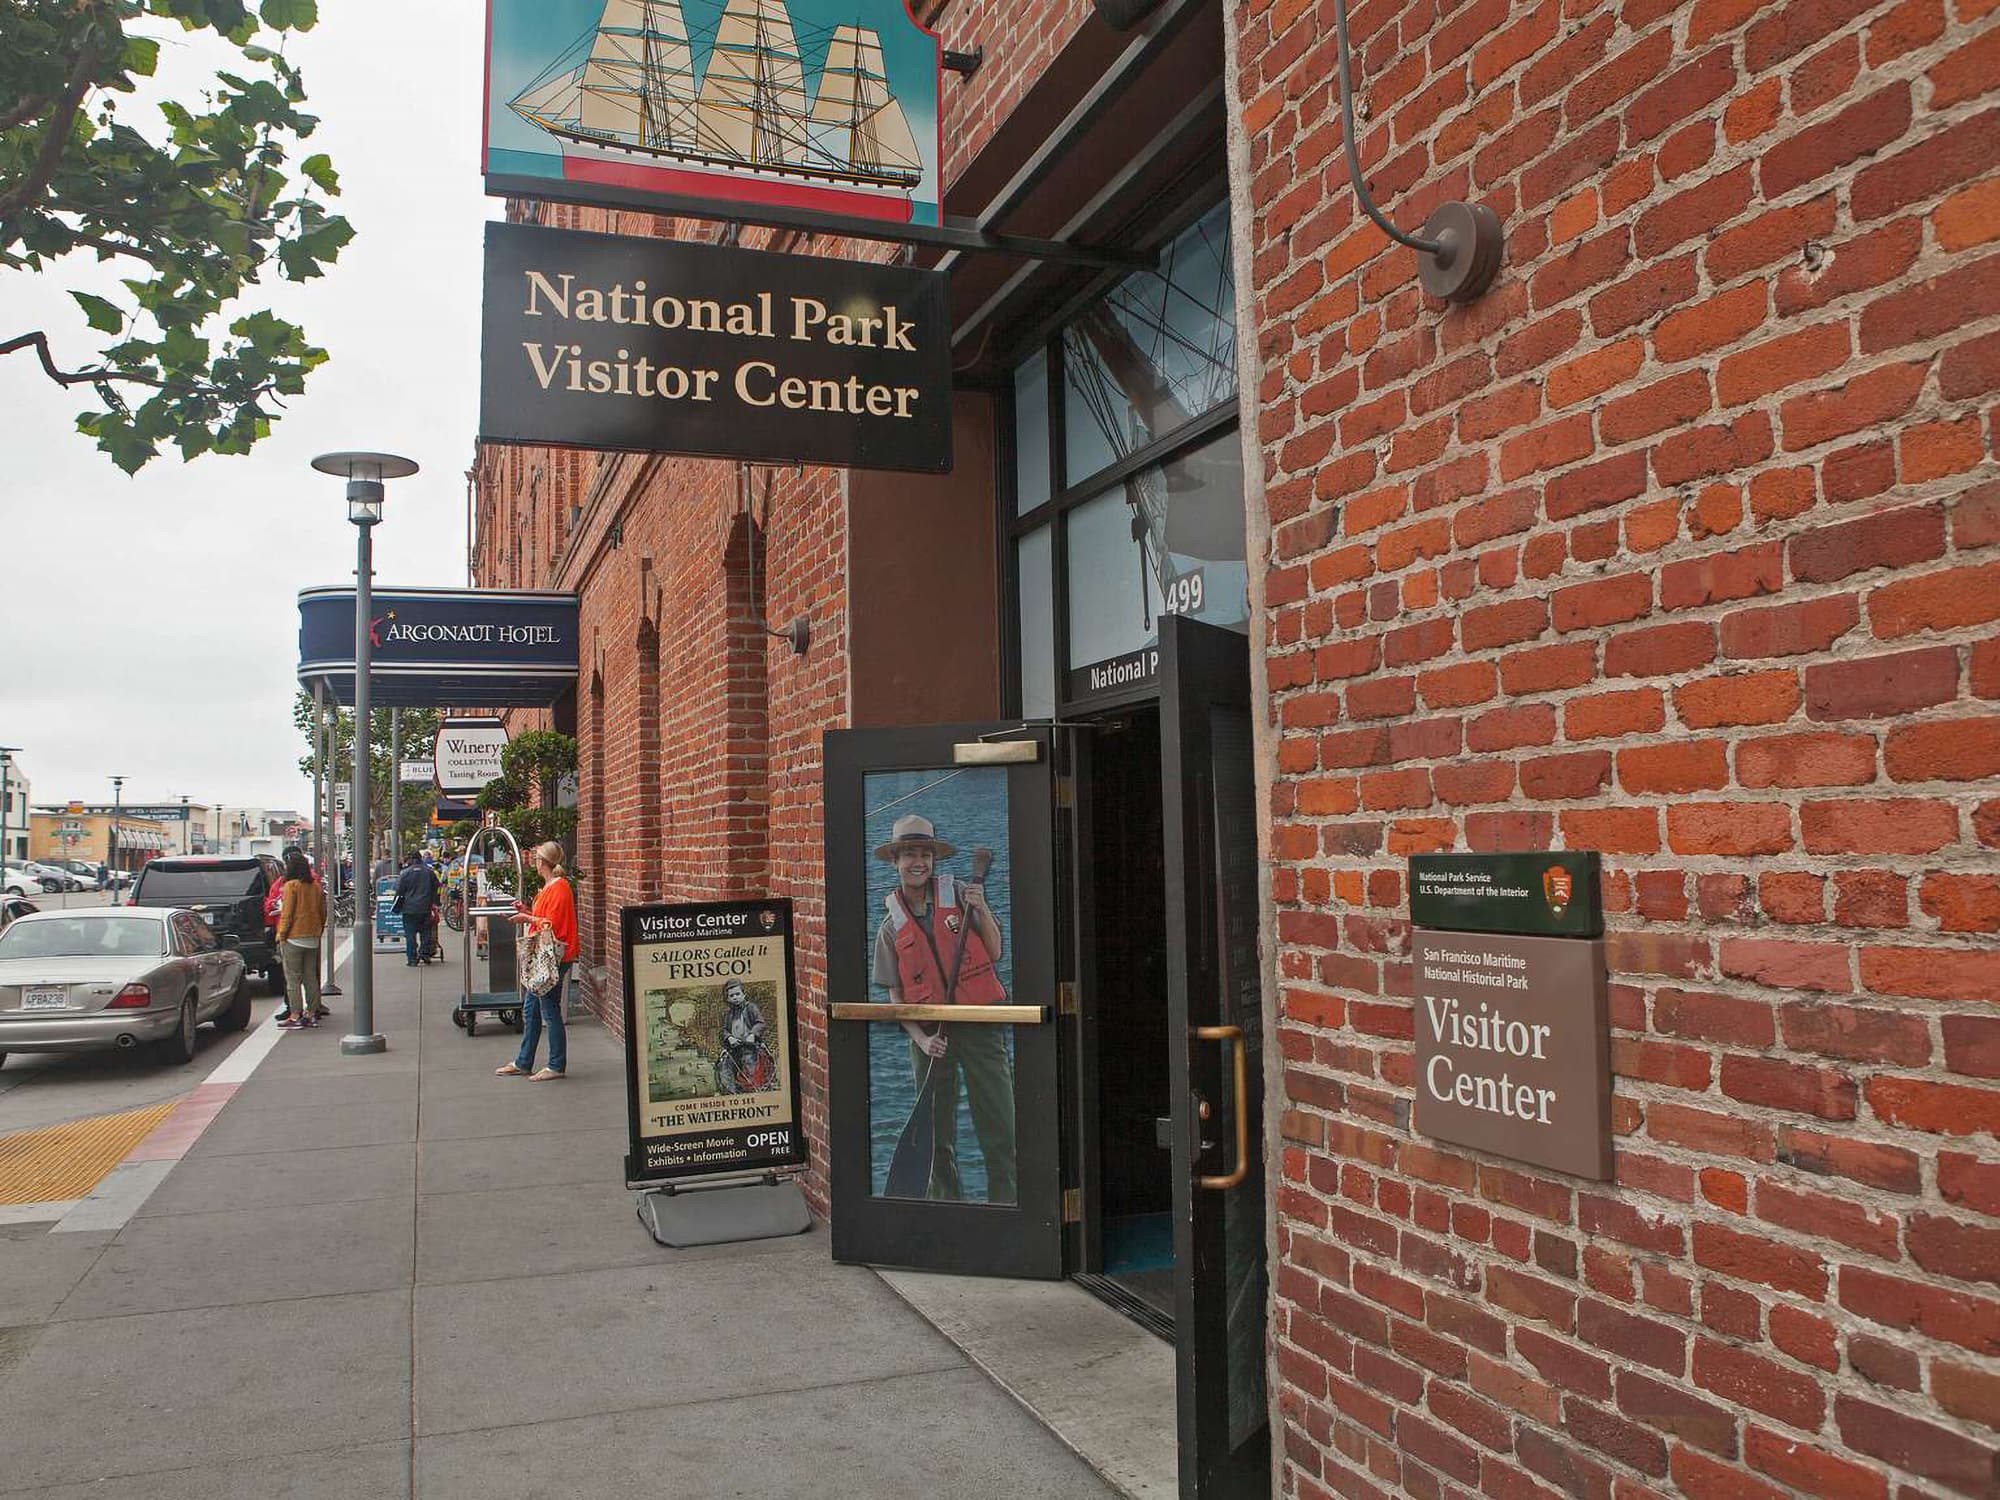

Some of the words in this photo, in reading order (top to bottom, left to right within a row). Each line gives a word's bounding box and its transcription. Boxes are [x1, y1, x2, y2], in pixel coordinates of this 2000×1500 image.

[524, 270, 775, 338] National
[789, 296, 917, 352] Park
[522, 342, 719, 402] Visitor
[734, 360, 920, 419] Center
[1166, 574, 1202, 615] 499
[386, 624, 495, 643] ARGONAUT
[499, 624, 561, 646] HOTEL
[1090, 652, 1146, 690] National
[446, 739, 500, 757] Winery
[447, 758, 498, 766] COLLECTIVE
[448, 770, 475, 780] Tasting
[477, 769, 500, 777] Room
[1419, 872, 1448, 882] National
[1448, 873, 1465, 882] Park
[1465, 873, 1492, 883] Service
[1419, 885, 1434, 895] U.S.
[1434, 885, 1475, 896] Department
[1476, 886, 1486, 896] of
[1486, 887, 1499, 896] the
[1500, 887, 1529, 897] Interior
[640, 915, 692, 931] Visitor
[696, 912, 748, 927] Center
[642, 932, 658, 940] San
[659, 929, 695, 939] Francisco
[696, 927, 733, 937] Maritime
[651, 948, 710, 963] SAILORS
[714, 945, 755, 959] Called
[757, 944, 768, 956] It
[1424, 948, 1440, 961] San
[1441, 949, 1481, 965] Francisco
[1483, 953, 1526, 970] Maritime
[669, 959, 752, 980] FRISCO!
[1424, 966, 1460, 982] National
[1462, 969, 1505, 987] Historical
[1507, 974, 1529, 990] Park
[1423, 995, 1551, 1060] Visitor
[1427, 1054, 1556, 1125] Center
[675, 1103, 697, 1112] COME
[700, 1101, 726, 1111] INSIDE
[742, 1097, 755, 1105] SEE
[647, 1141, 704, 1155] Wide-Screen
[706, 1137, 735, 1149] Movie
[747, 1130, 789, 1148] OPEN
[648, 1156, 685, 1168] Exhibits
[693, 1148, 747, 1162] Information
[771, 1146, 791, 1156] FREE
